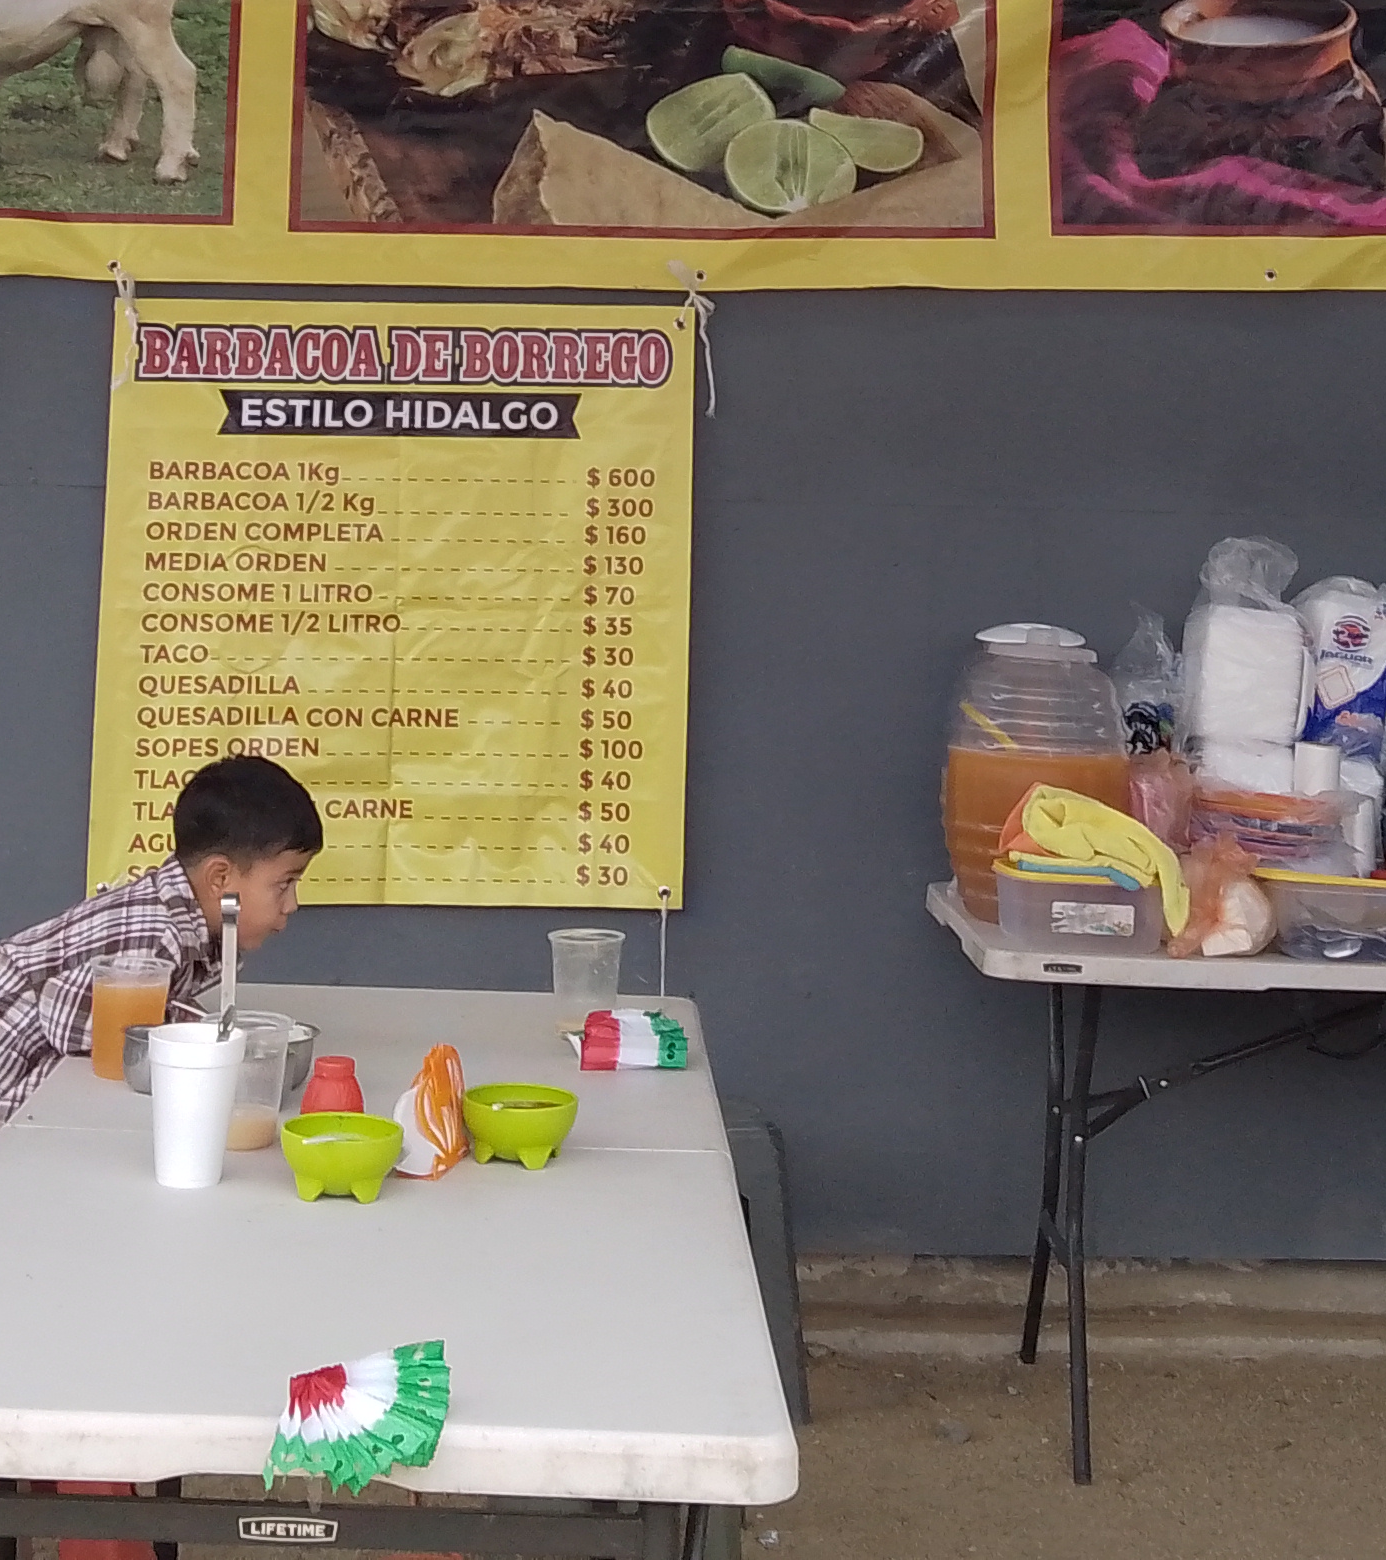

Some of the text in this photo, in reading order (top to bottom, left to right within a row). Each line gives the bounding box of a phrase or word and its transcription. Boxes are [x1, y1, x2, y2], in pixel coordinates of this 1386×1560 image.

[137, 326, 669, 385] BARBACOA DE BORREGO
[240, 397, 559, 431] ESTILO HIDALGO
[149, 461, 656, 490] BARBACOA 1Kg $ 600
[147, 490, 654, 520] BARBACOA 1/2 Kg $ 300
[145, 521, 647, 547] ORDEN COMPLETA $ 160
[144, 552, 644, 577] MEDIA ORDEN $ 130
[142, 582, 635, 607] CONSOME 1 LITRO $ 70
[140, 610, 633, 638] CONSOME 1/2 LITRO $ 35
[139, 644, 634, 668] TACO $ 30
[1319, 648, 1373, 664] JAGUAR
[138, 674, 633, 701] QUESADILLA $ 40
[136, 706, 632, 732] QUESADILLA CON CARNE $ 50
[134, 737, 643, 761] SOPES ORDEN $ 100
[578, 768, 593, 792] $
[600, 770, 632, 791] 40
[324, 798, 631, 823] CARNE $ 50
[577, 832, 592, 856] $
[599, 834, 630, 855] 40
[575, 864, 628, 887] $ 30
[249, 1521, 326, 1538] LIFETIME
